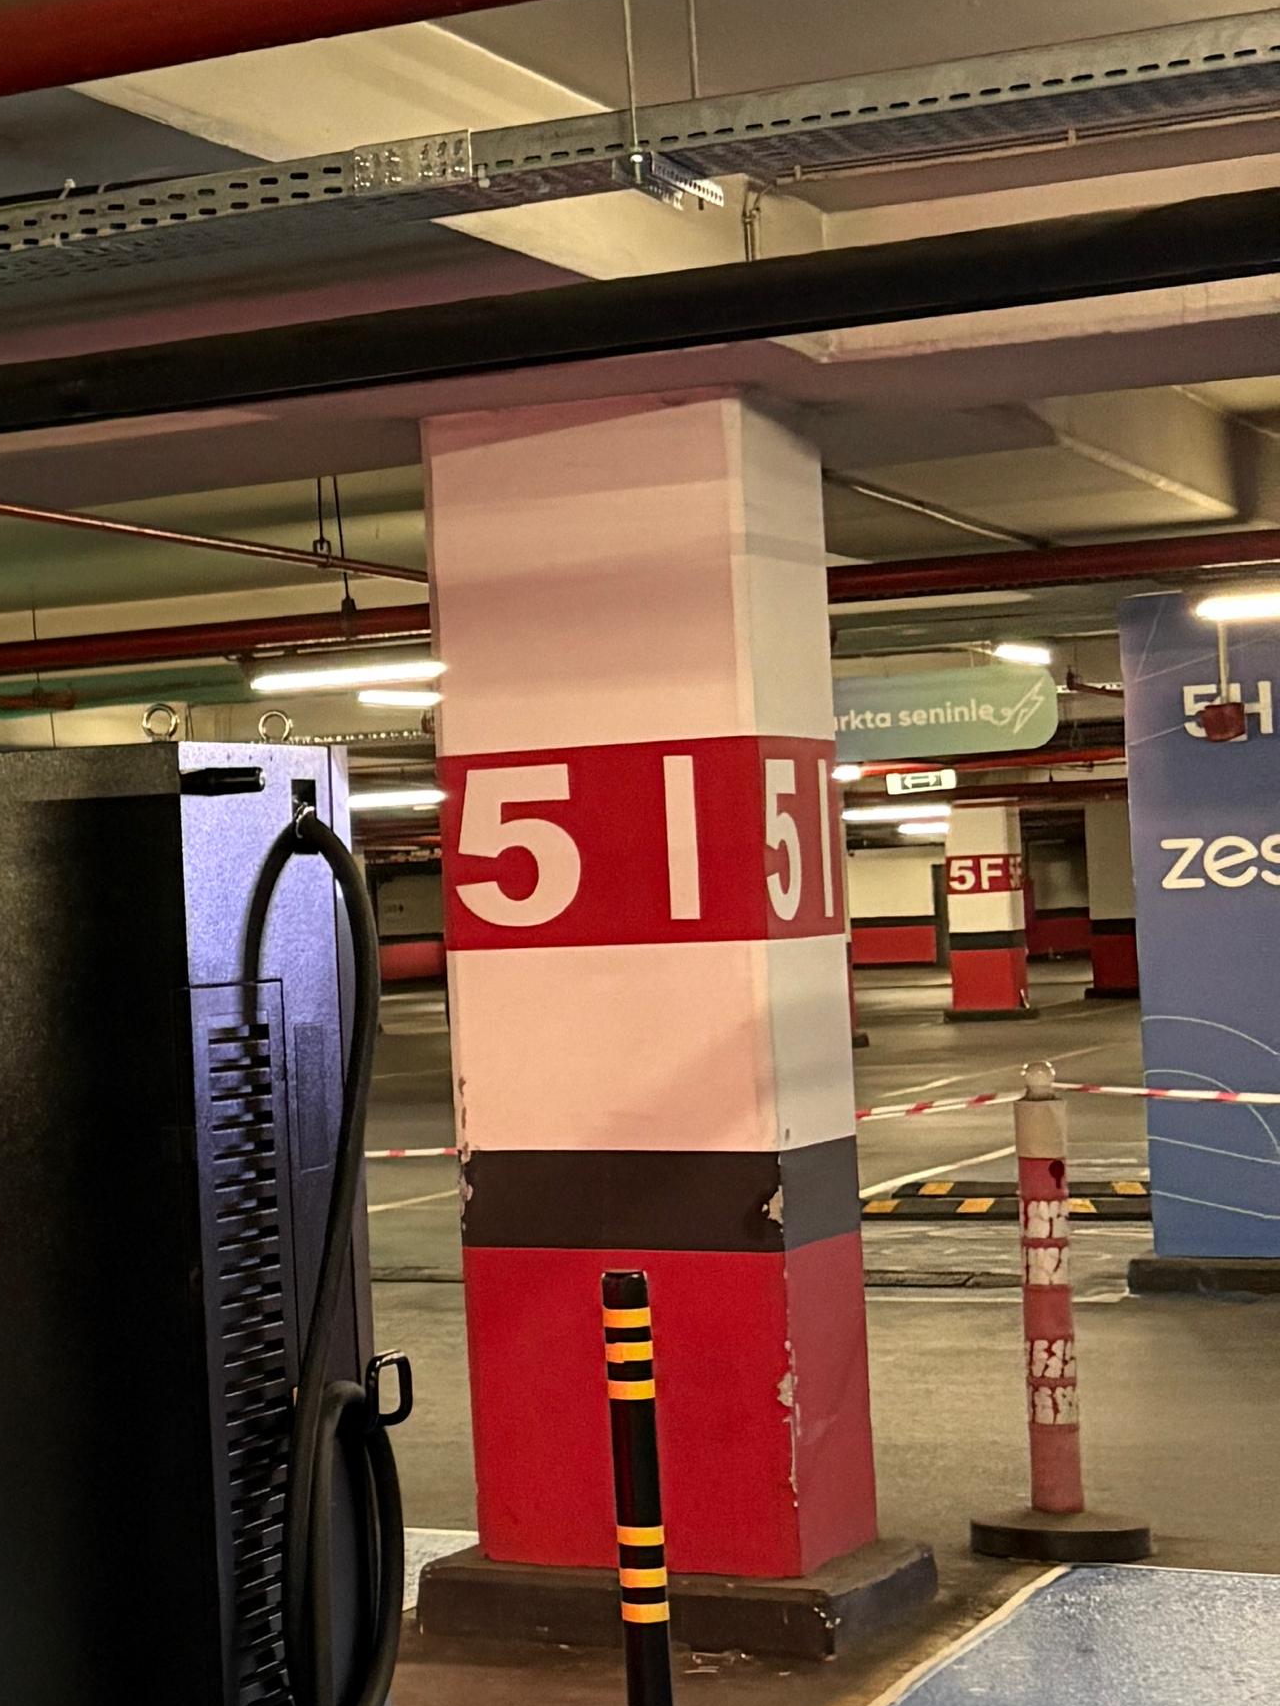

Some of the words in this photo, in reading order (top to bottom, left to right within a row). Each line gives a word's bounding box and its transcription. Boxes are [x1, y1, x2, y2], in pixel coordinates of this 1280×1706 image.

[833, 709, 892, 732] rkta
[899, 699, 993, 727] seninle
[455, 763, 581, 927] 5
[949, 858, 1003, 890] 5F
